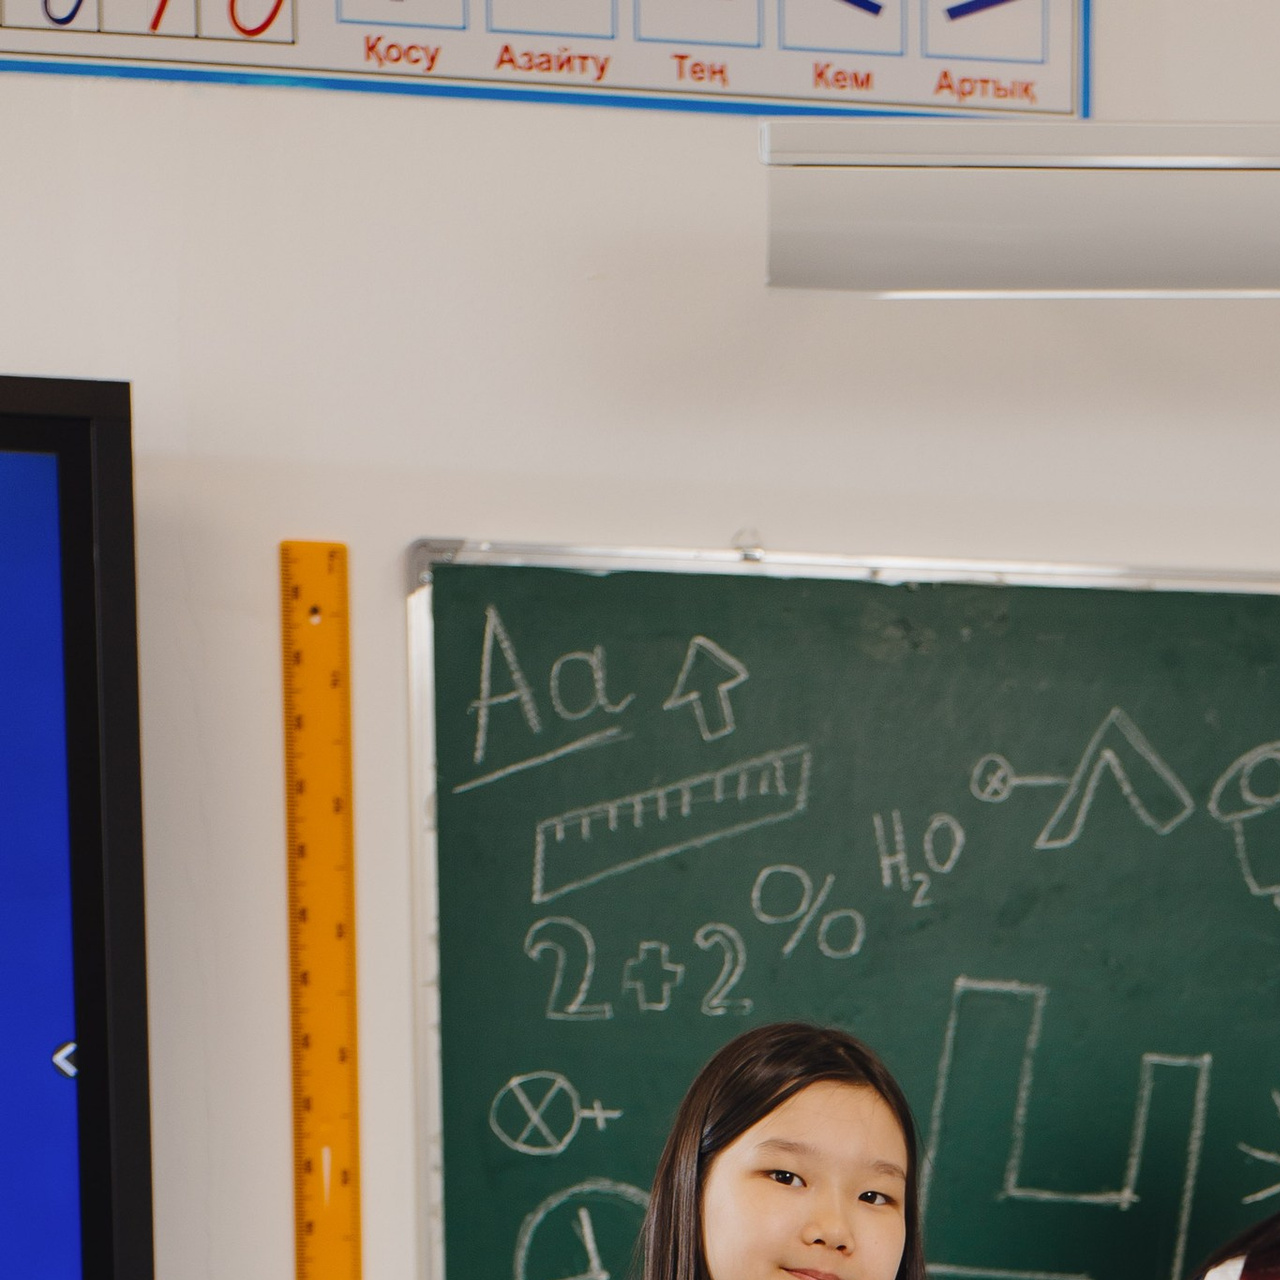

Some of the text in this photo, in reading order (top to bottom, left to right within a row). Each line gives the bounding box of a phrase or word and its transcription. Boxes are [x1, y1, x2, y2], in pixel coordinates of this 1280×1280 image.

[364, 36, 441, 73] Қосу
[495, 43, 611, 84] Азайту
[813, 62, 874, 93] Кем
[934, 68, 1039, 106] Артық
[467, 603, 636, 765] Aa
